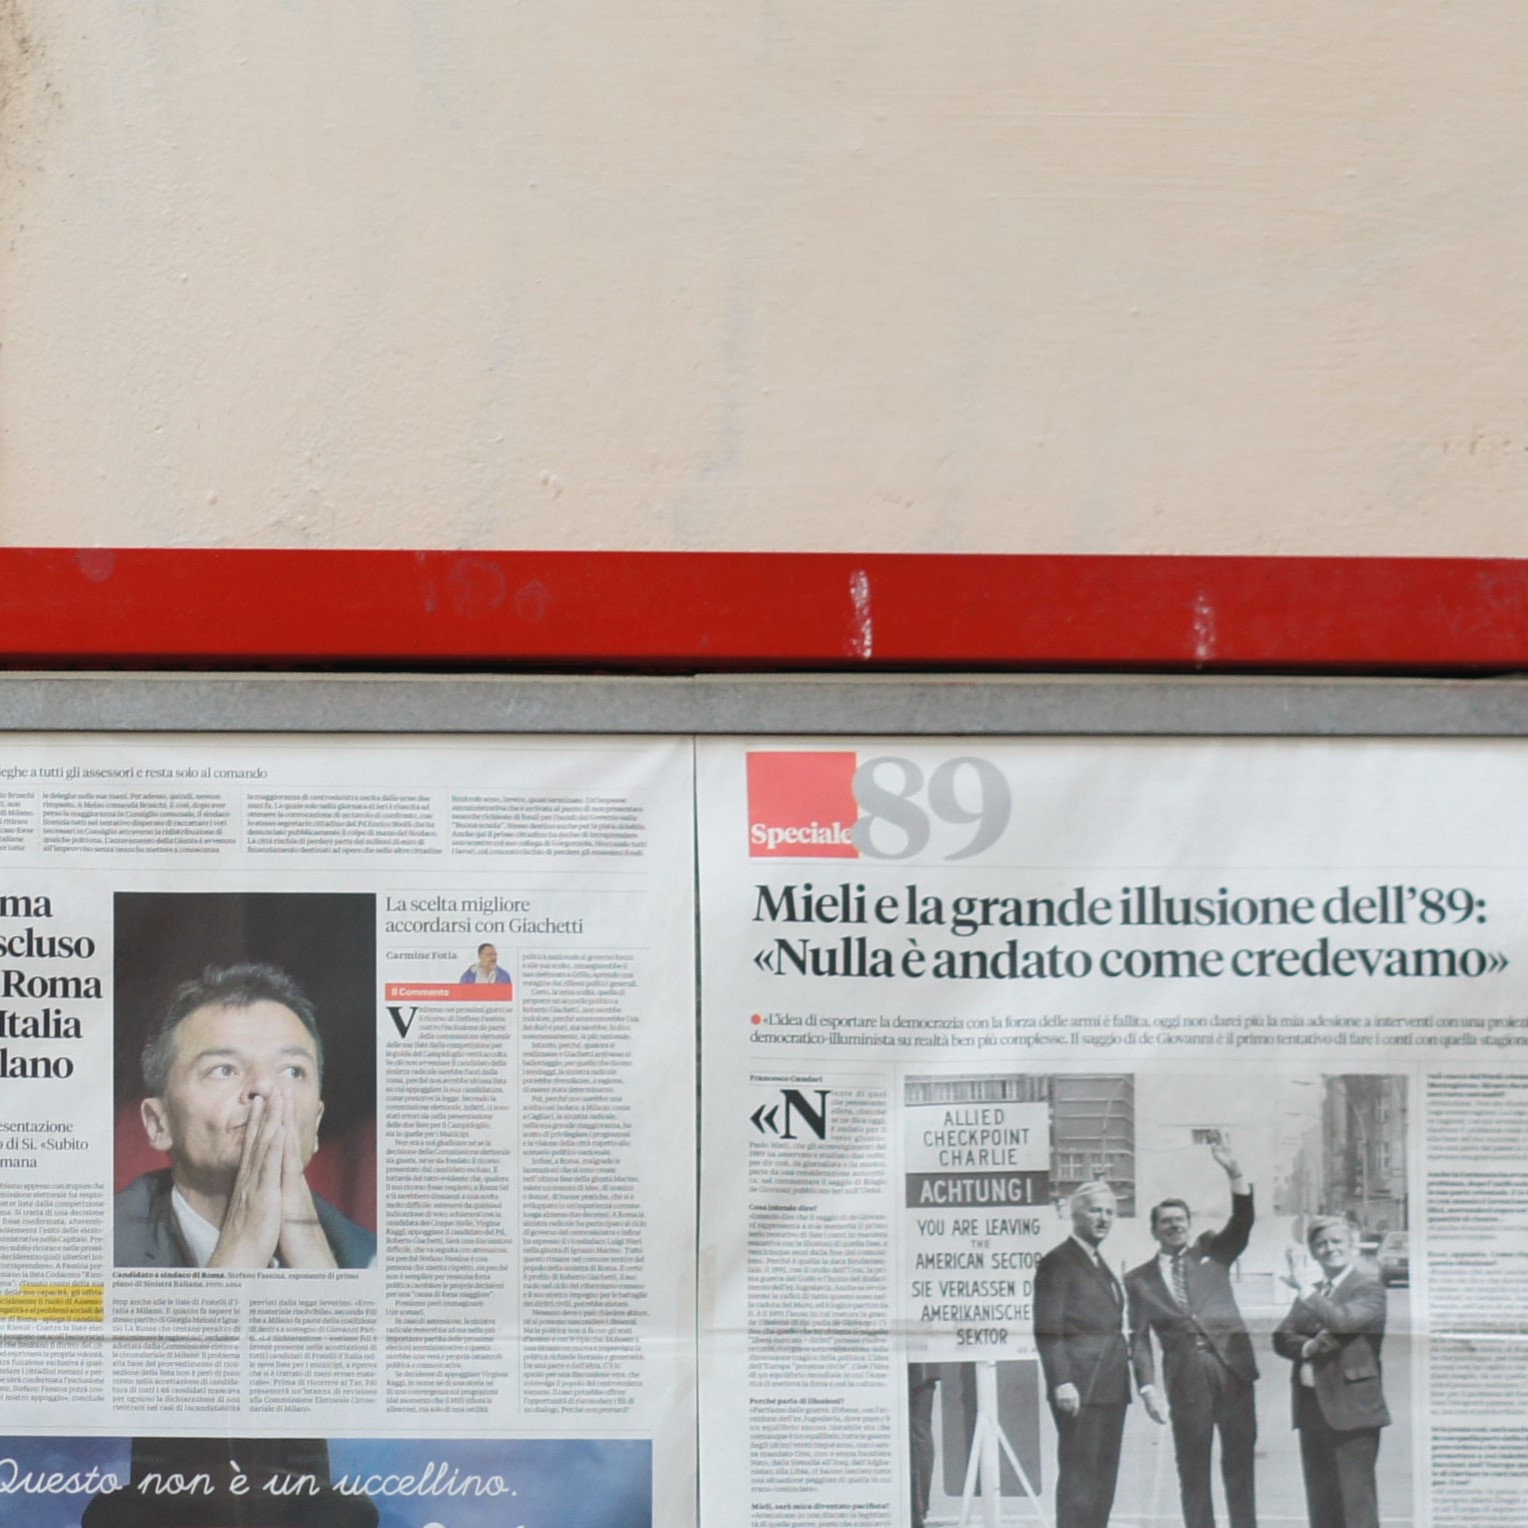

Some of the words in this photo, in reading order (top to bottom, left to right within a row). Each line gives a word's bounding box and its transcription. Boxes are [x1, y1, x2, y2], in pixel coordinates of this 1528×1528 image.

[750, 822, 854, 849] Speciale
[851, 756, 1012, 862] 89
[386, 896, 407, 911] La
[410, 895, 457, 912] scelta
[461, 896, 530, 916] migliore
[753, 883, 867, 923] Mieli
[875, 896, 898, 924] e
[906, 884, 945, 925] la
[951, 887, 1112, 937] grande
[1120, 886, 1312, 926] illusione
[385, 916, 471, 933] accordarsi
[475, 921, 505, 933] con
[509, 917, 583, 934] Giachetti
[386, 951, 430, 960] Carmine
[431, 951, 457, 960] Fotia
[754, 936, 895, 978] «Nulla
[901, 938, 925, 978] è
[932, 939, 1092, 979] andato
[1100, 950, 1223, 978] come
[1231, 937, 1509, 977] credevamo»
[1, 970, 102, 999] Roma
[391, 987, 399, 997] Il
[398, 987, 450, 997] Commento
[944, 1108, 1005, 1126] ALLIED
[924, 1128, 1029, 1147] CHECKPOINT
[939, 1148, 1017, 1167] CHARLIE
[920, 1177, 1033, 1204] ACHTUNG!
[917, 1219, 945, 1236] YOU
[952, 1219, 978, 1236] ARE
[986, 1218, 1041, 1236] LEAVING
[971, 1239, 990, 1249] THE
[916, 1253, 984, 1270] AMERICAN
[912, 1281, 932, 1298] SIE
[939, 1280, 1015, 1297] VERLASSEN
[920, 1303, 1033, 1322] AMERIKANISCHE
[956, 1328, 1008, 1346] SEKTOR
[138, 1472, 214, 1497] non
[228, 1460, 250, 1496] è
[262, 1473, 320, 1497] un
[332, 1461, 518, 1498] uccellino.
